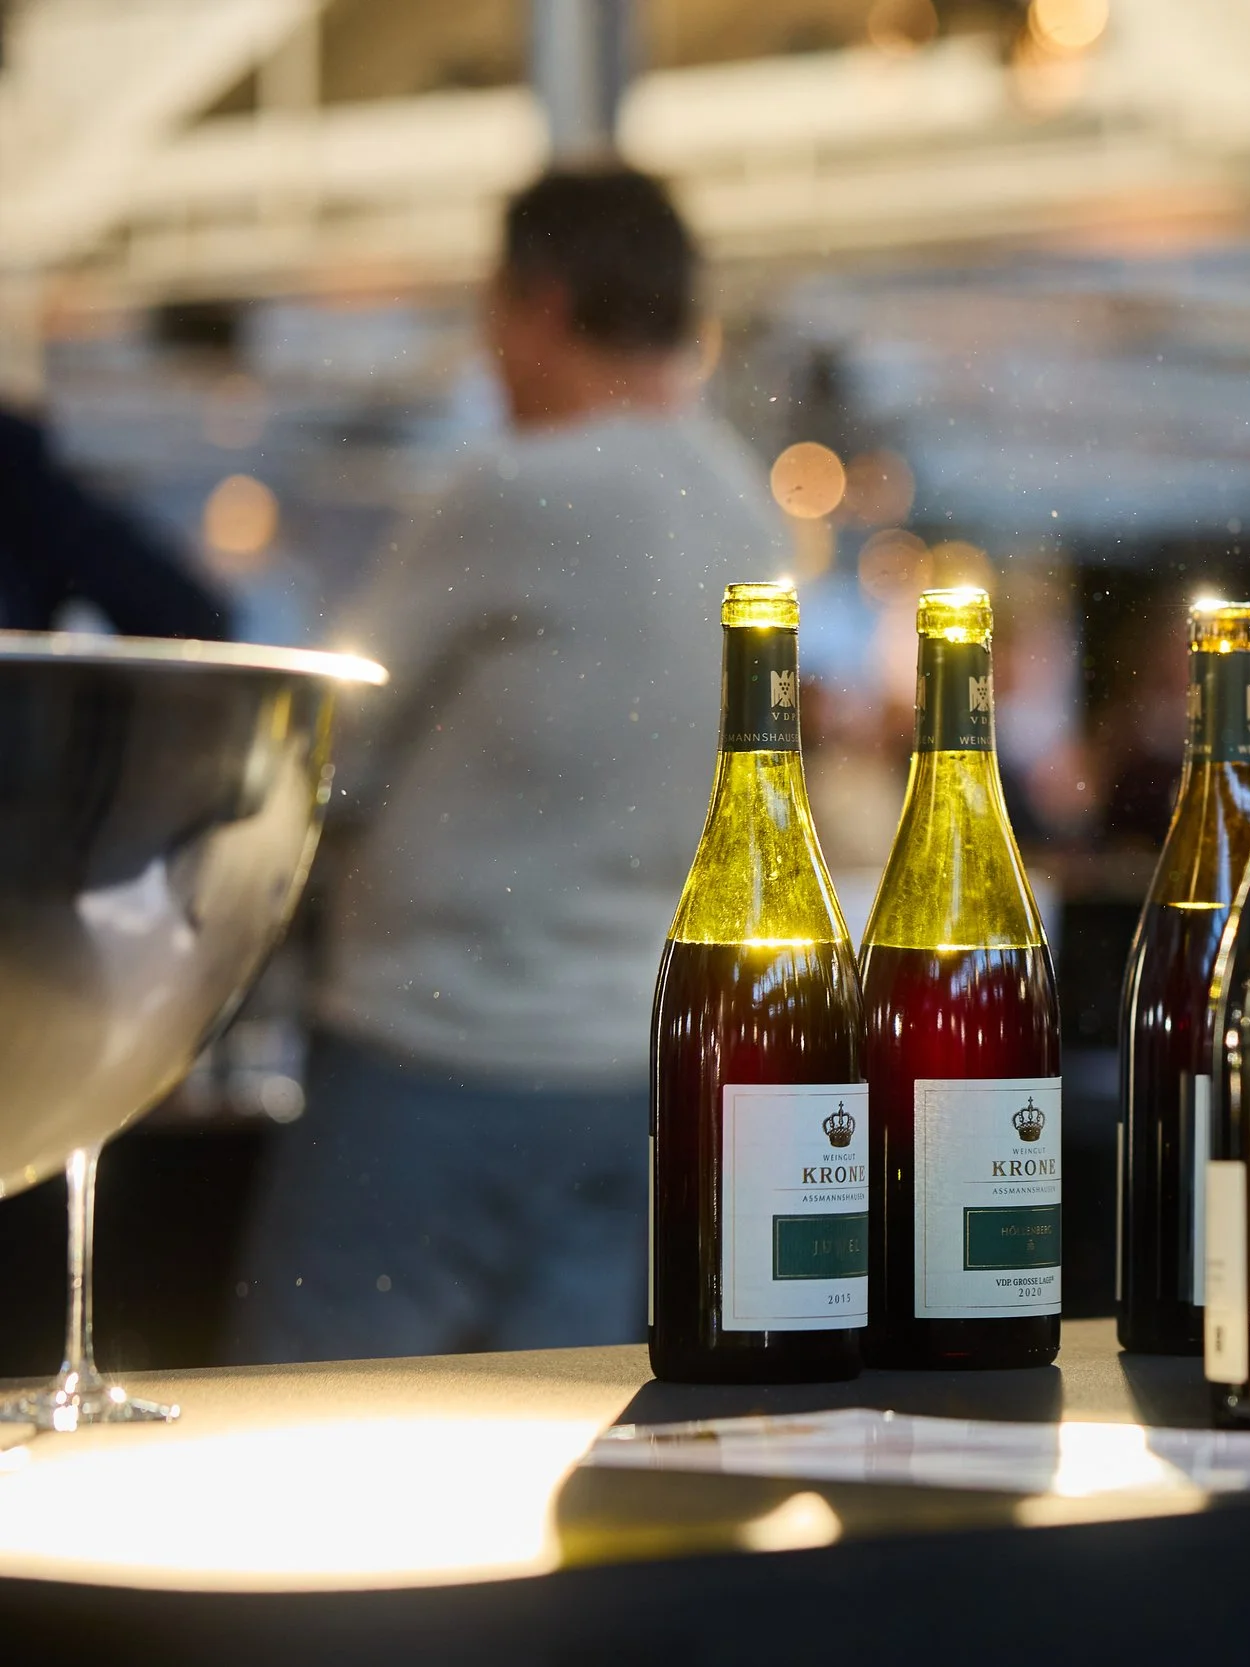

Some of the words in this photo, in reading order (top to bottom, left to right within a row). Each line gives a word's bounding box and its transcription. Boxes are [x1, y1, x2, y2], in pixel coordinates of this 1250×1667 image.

[1012, 1147, 1046, 1156] WEINGUT
[822, 1153, 856, 1162] WEINGUT
[991, 1158, 1056, 1177] KRONE
[802, 1165, 866, 1184] KRONE
[1018, 1287, 1042, 1298] 2020
[828, 1293, 851, 1305] 2015
